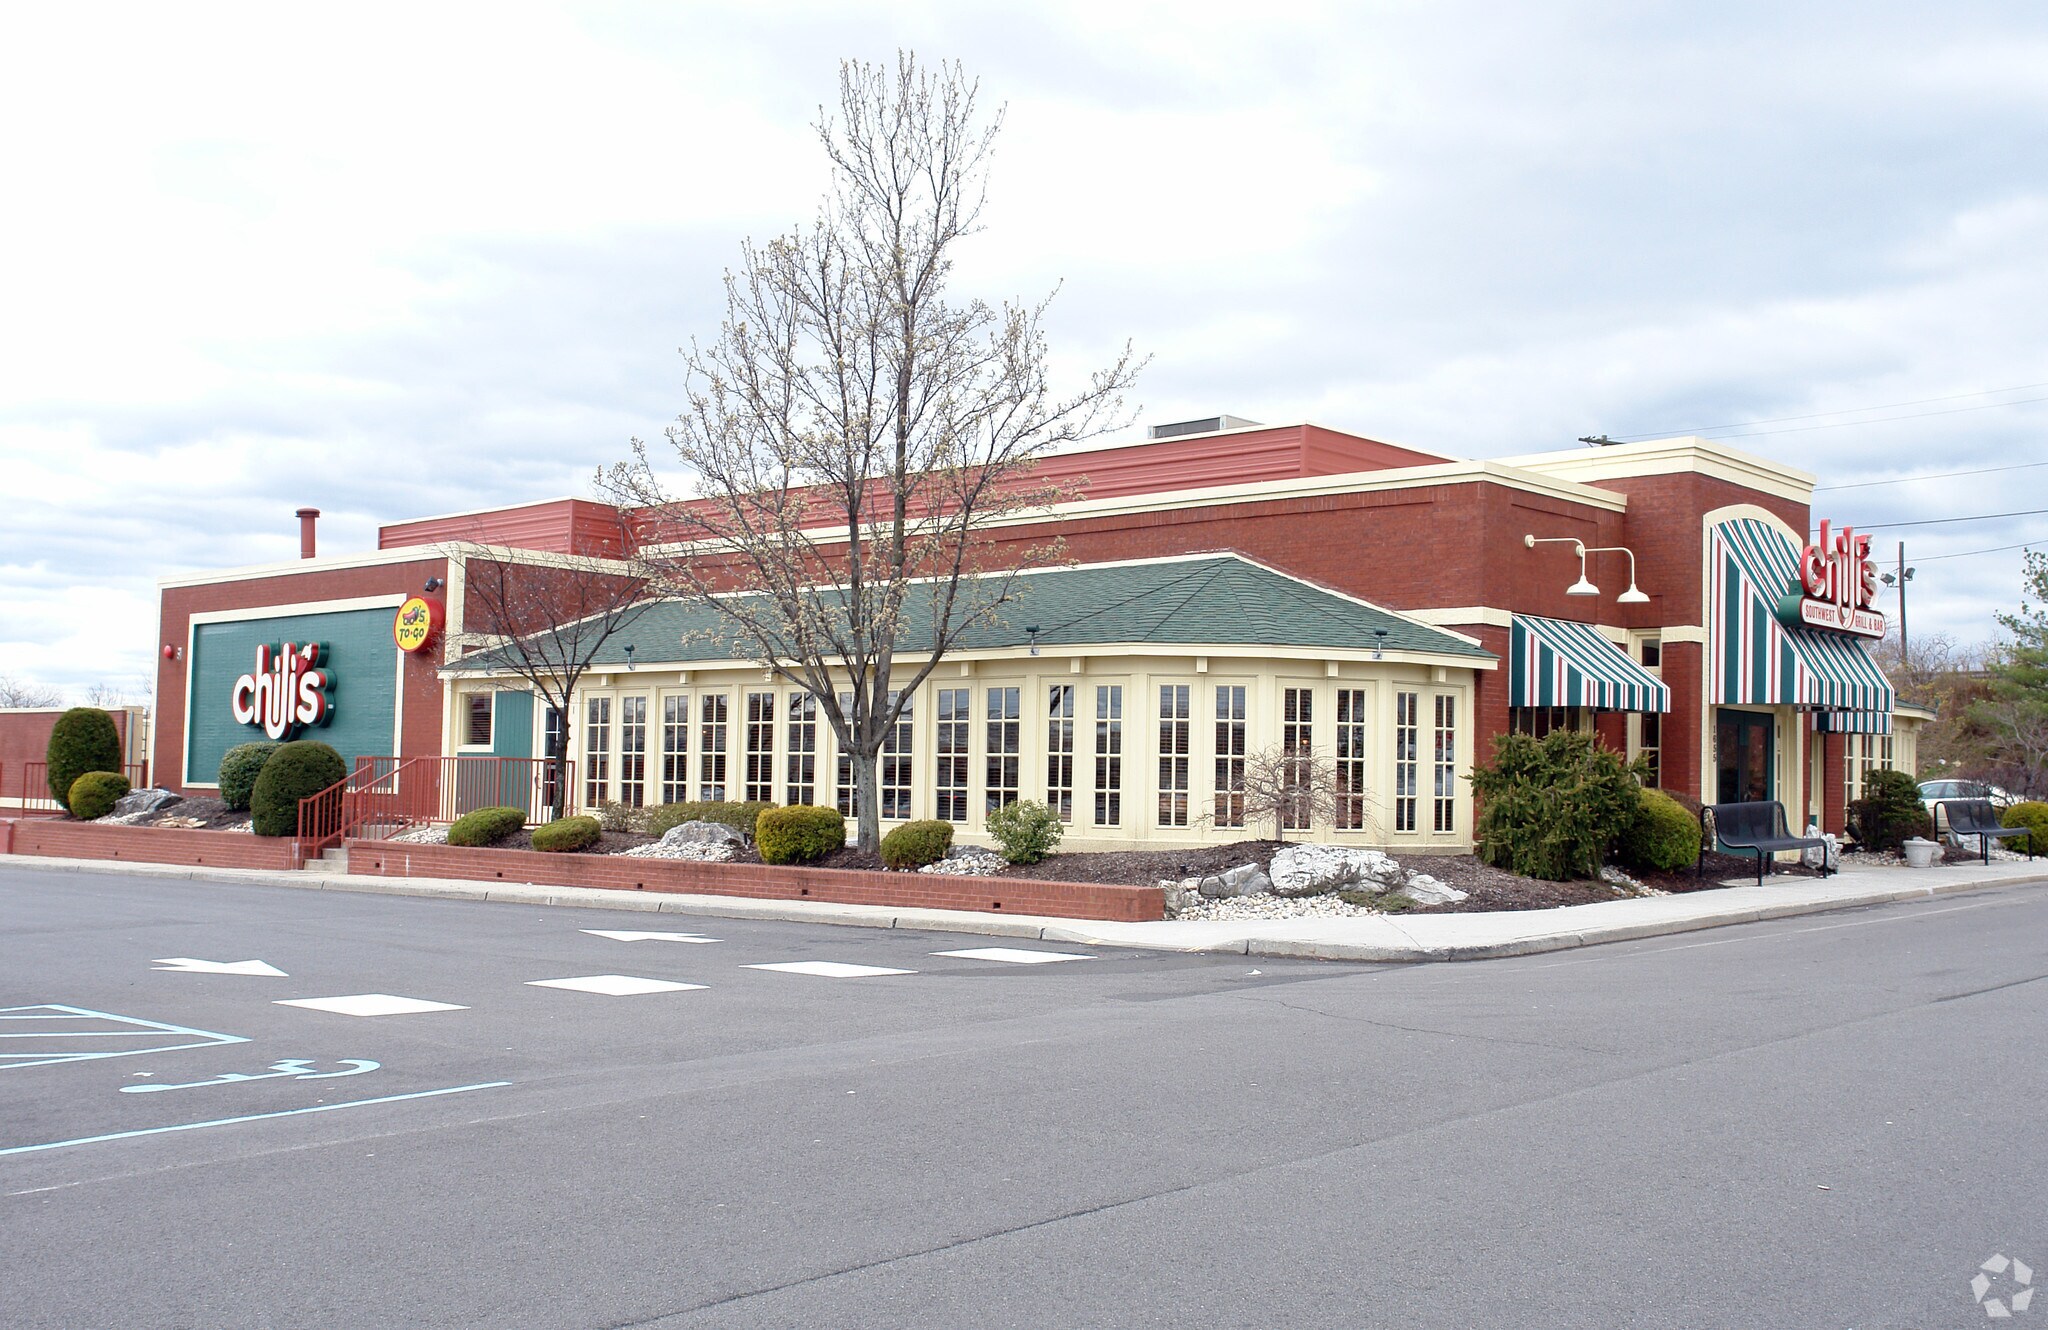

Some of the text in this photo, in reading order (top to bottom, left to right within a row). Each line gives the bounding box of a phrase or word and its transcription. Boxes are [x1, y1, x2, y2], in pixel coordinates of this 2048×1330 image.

[1806, 605, 1883, 632] SOUTHWEST GRILL & BAR
[232, 642, 322, 740] chili's
